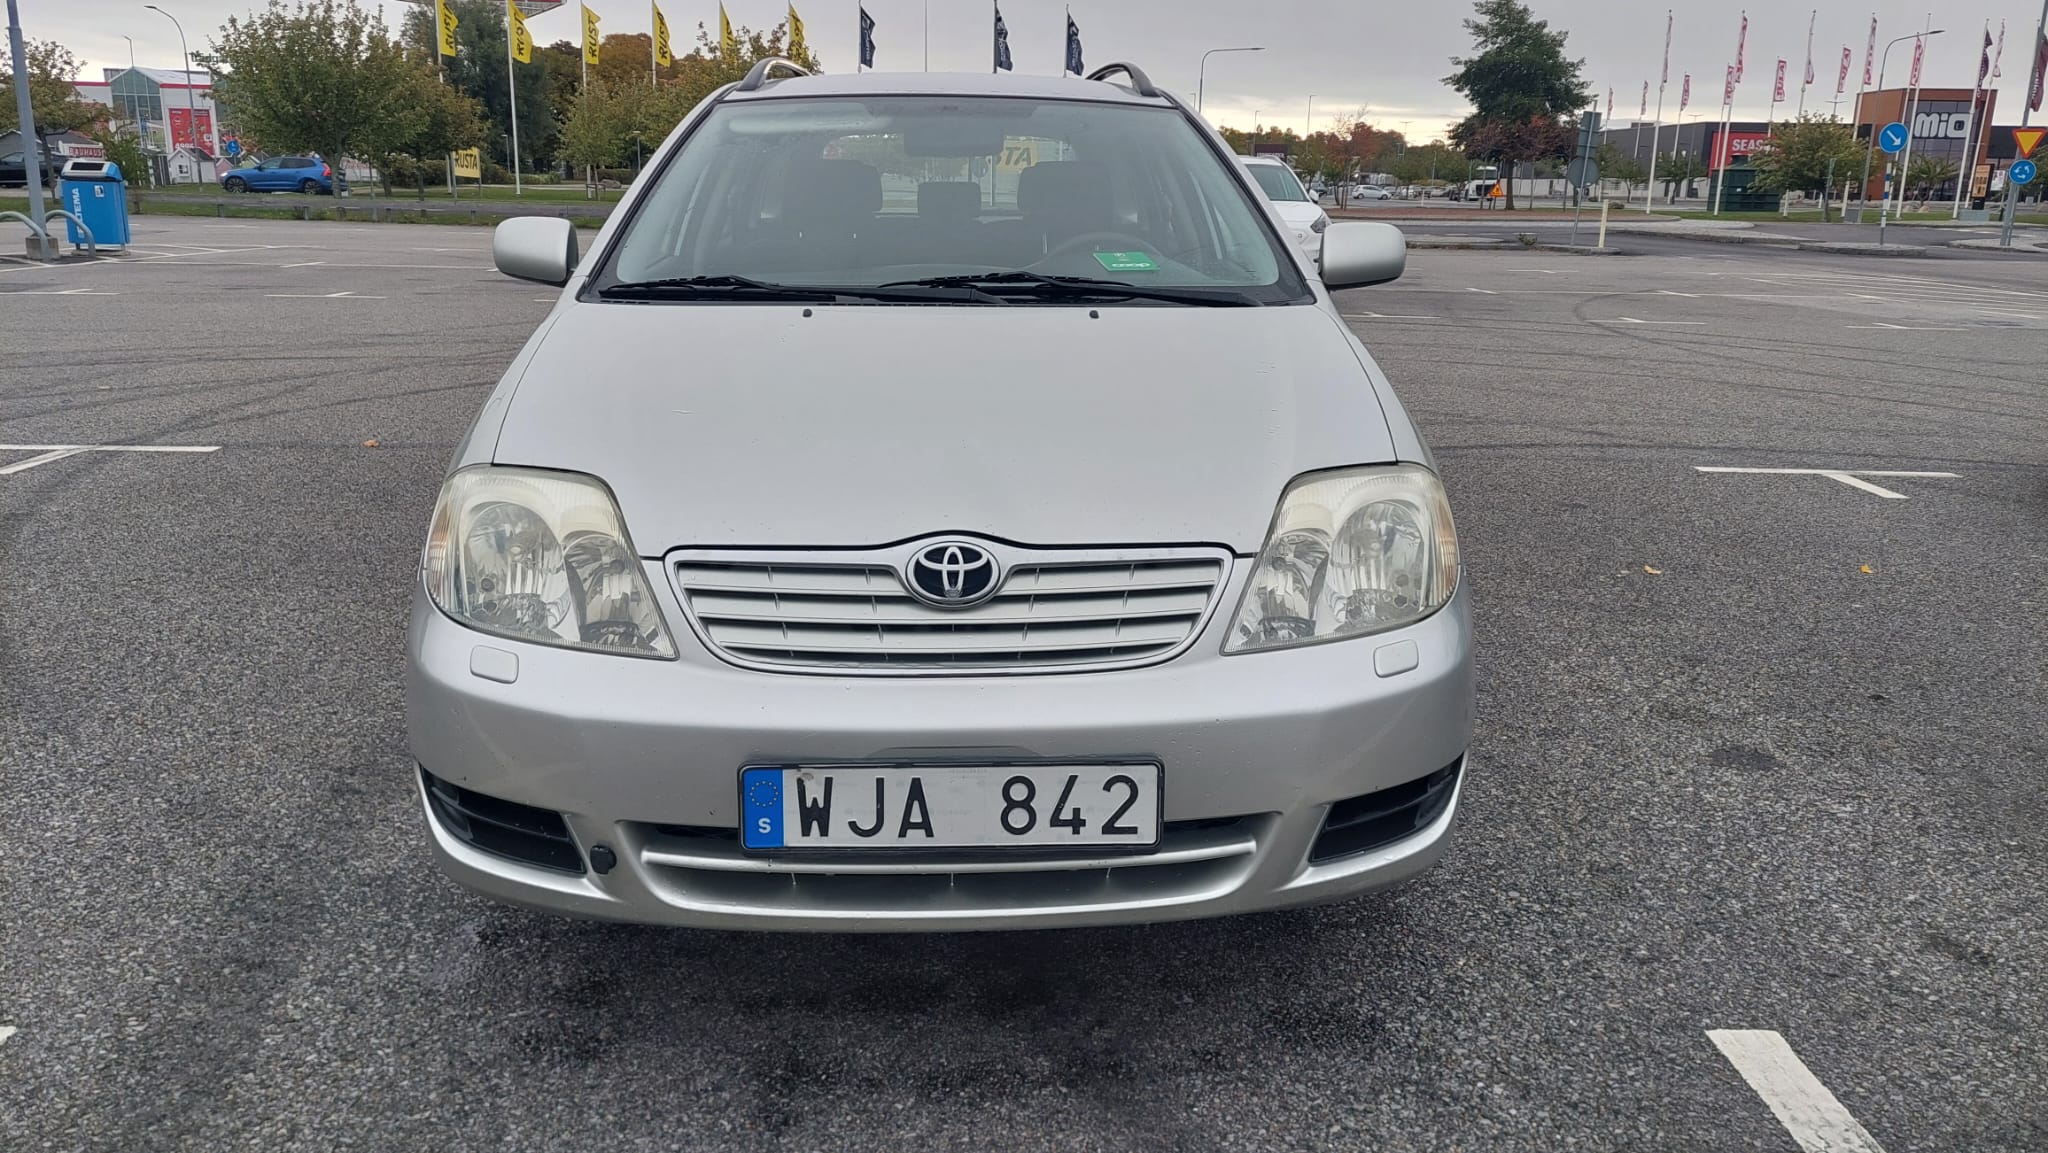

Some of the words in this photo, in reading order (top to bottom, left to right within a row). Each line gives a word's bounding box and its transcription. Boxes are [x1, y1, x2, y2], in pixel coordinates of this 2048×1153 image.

[69, 147, 103, 159] BAUHAUS
[796, 776, 935, 838] WJA
[1000, 774, 1140, 836] 842
[757, 817, 772, 834] S
